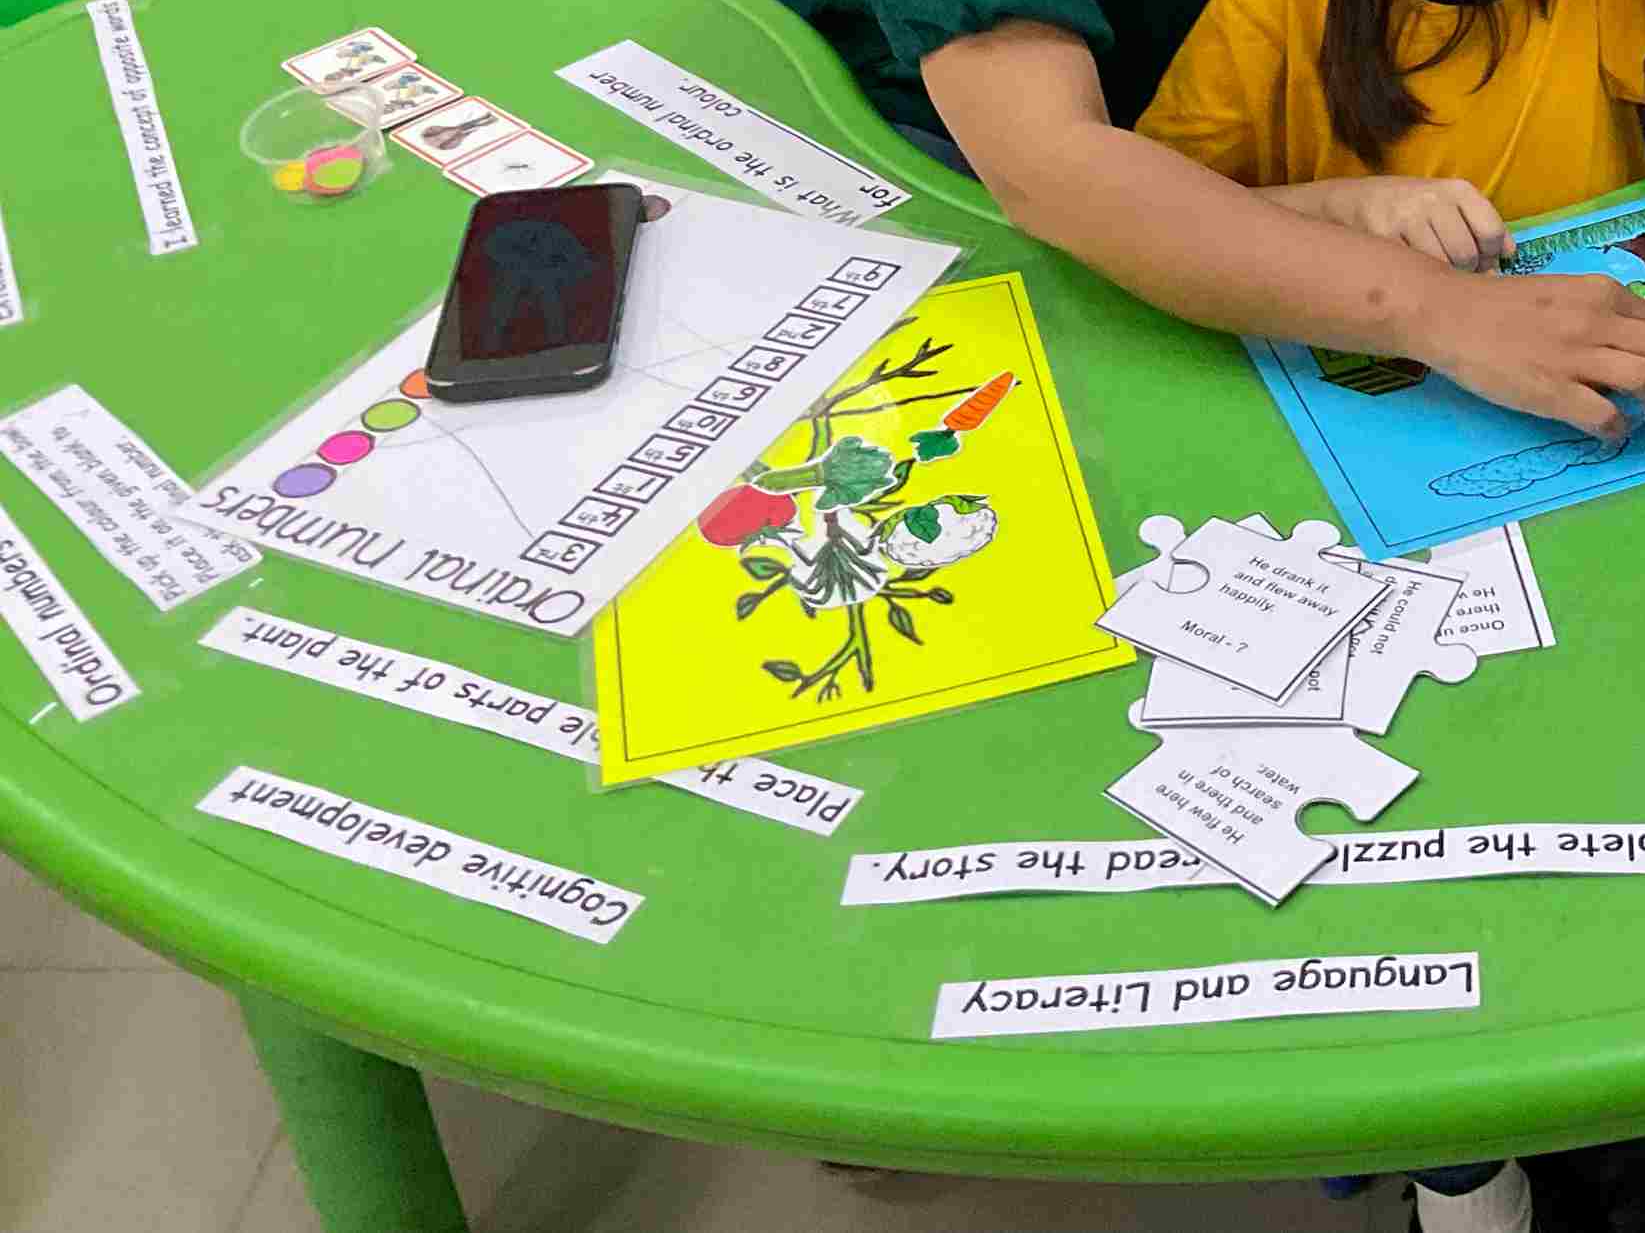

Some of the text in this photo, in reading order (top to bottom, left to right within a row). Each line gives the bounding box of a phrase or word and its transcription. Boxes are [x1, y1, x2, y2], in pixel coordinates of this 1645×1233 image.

[111, 35, 144, 84] opposite
[130, 105, 161, 151] concept
[588, 71, 860, 225] What is the ordinal number
[143, 154, 168, 179] the
[147, 180, 183, 234] learned
[858, 184, 902, 208] for
[199, 483, 586, 624] Ordinal numbers
[1248, 555, 1270, 570] He
[1271, 566, 1315, 589] drank
[1315, 582, 1330, 594] it
[1233, 571, 1338, 617] and flew away
[1401, 579, 1423, 597] He
[1455, 602, 1501, 617] there
[0, 539, 123, 706] Ordinal numbers
[1180, 619, 1249, 653] Moral ?
[1382, 598, 1409, 633] could
[1459, 619, 1505, 634] Once
[242, 617, 339, 660] plant.
[1369, 633, 1389, 655] not
[337, 649, 395, 681] the
[394, 666, 446, 693] of
[452, 682, 558, 725] parts
[752, 772, 851, 823] Place
[1177, 769, 1264, 825] and there in
[1208, 765, 1283, 810] search of
[1154, 783, 1245, 845] He flew here
[230, 779, 629, 926] Cognitive development
[872, 852, 997, 882] story.
[1017, 850, 1086, 879] the
[1467, 832, 1537, 861] the
[960, 956, 1472, 1014] Language and Literacy
